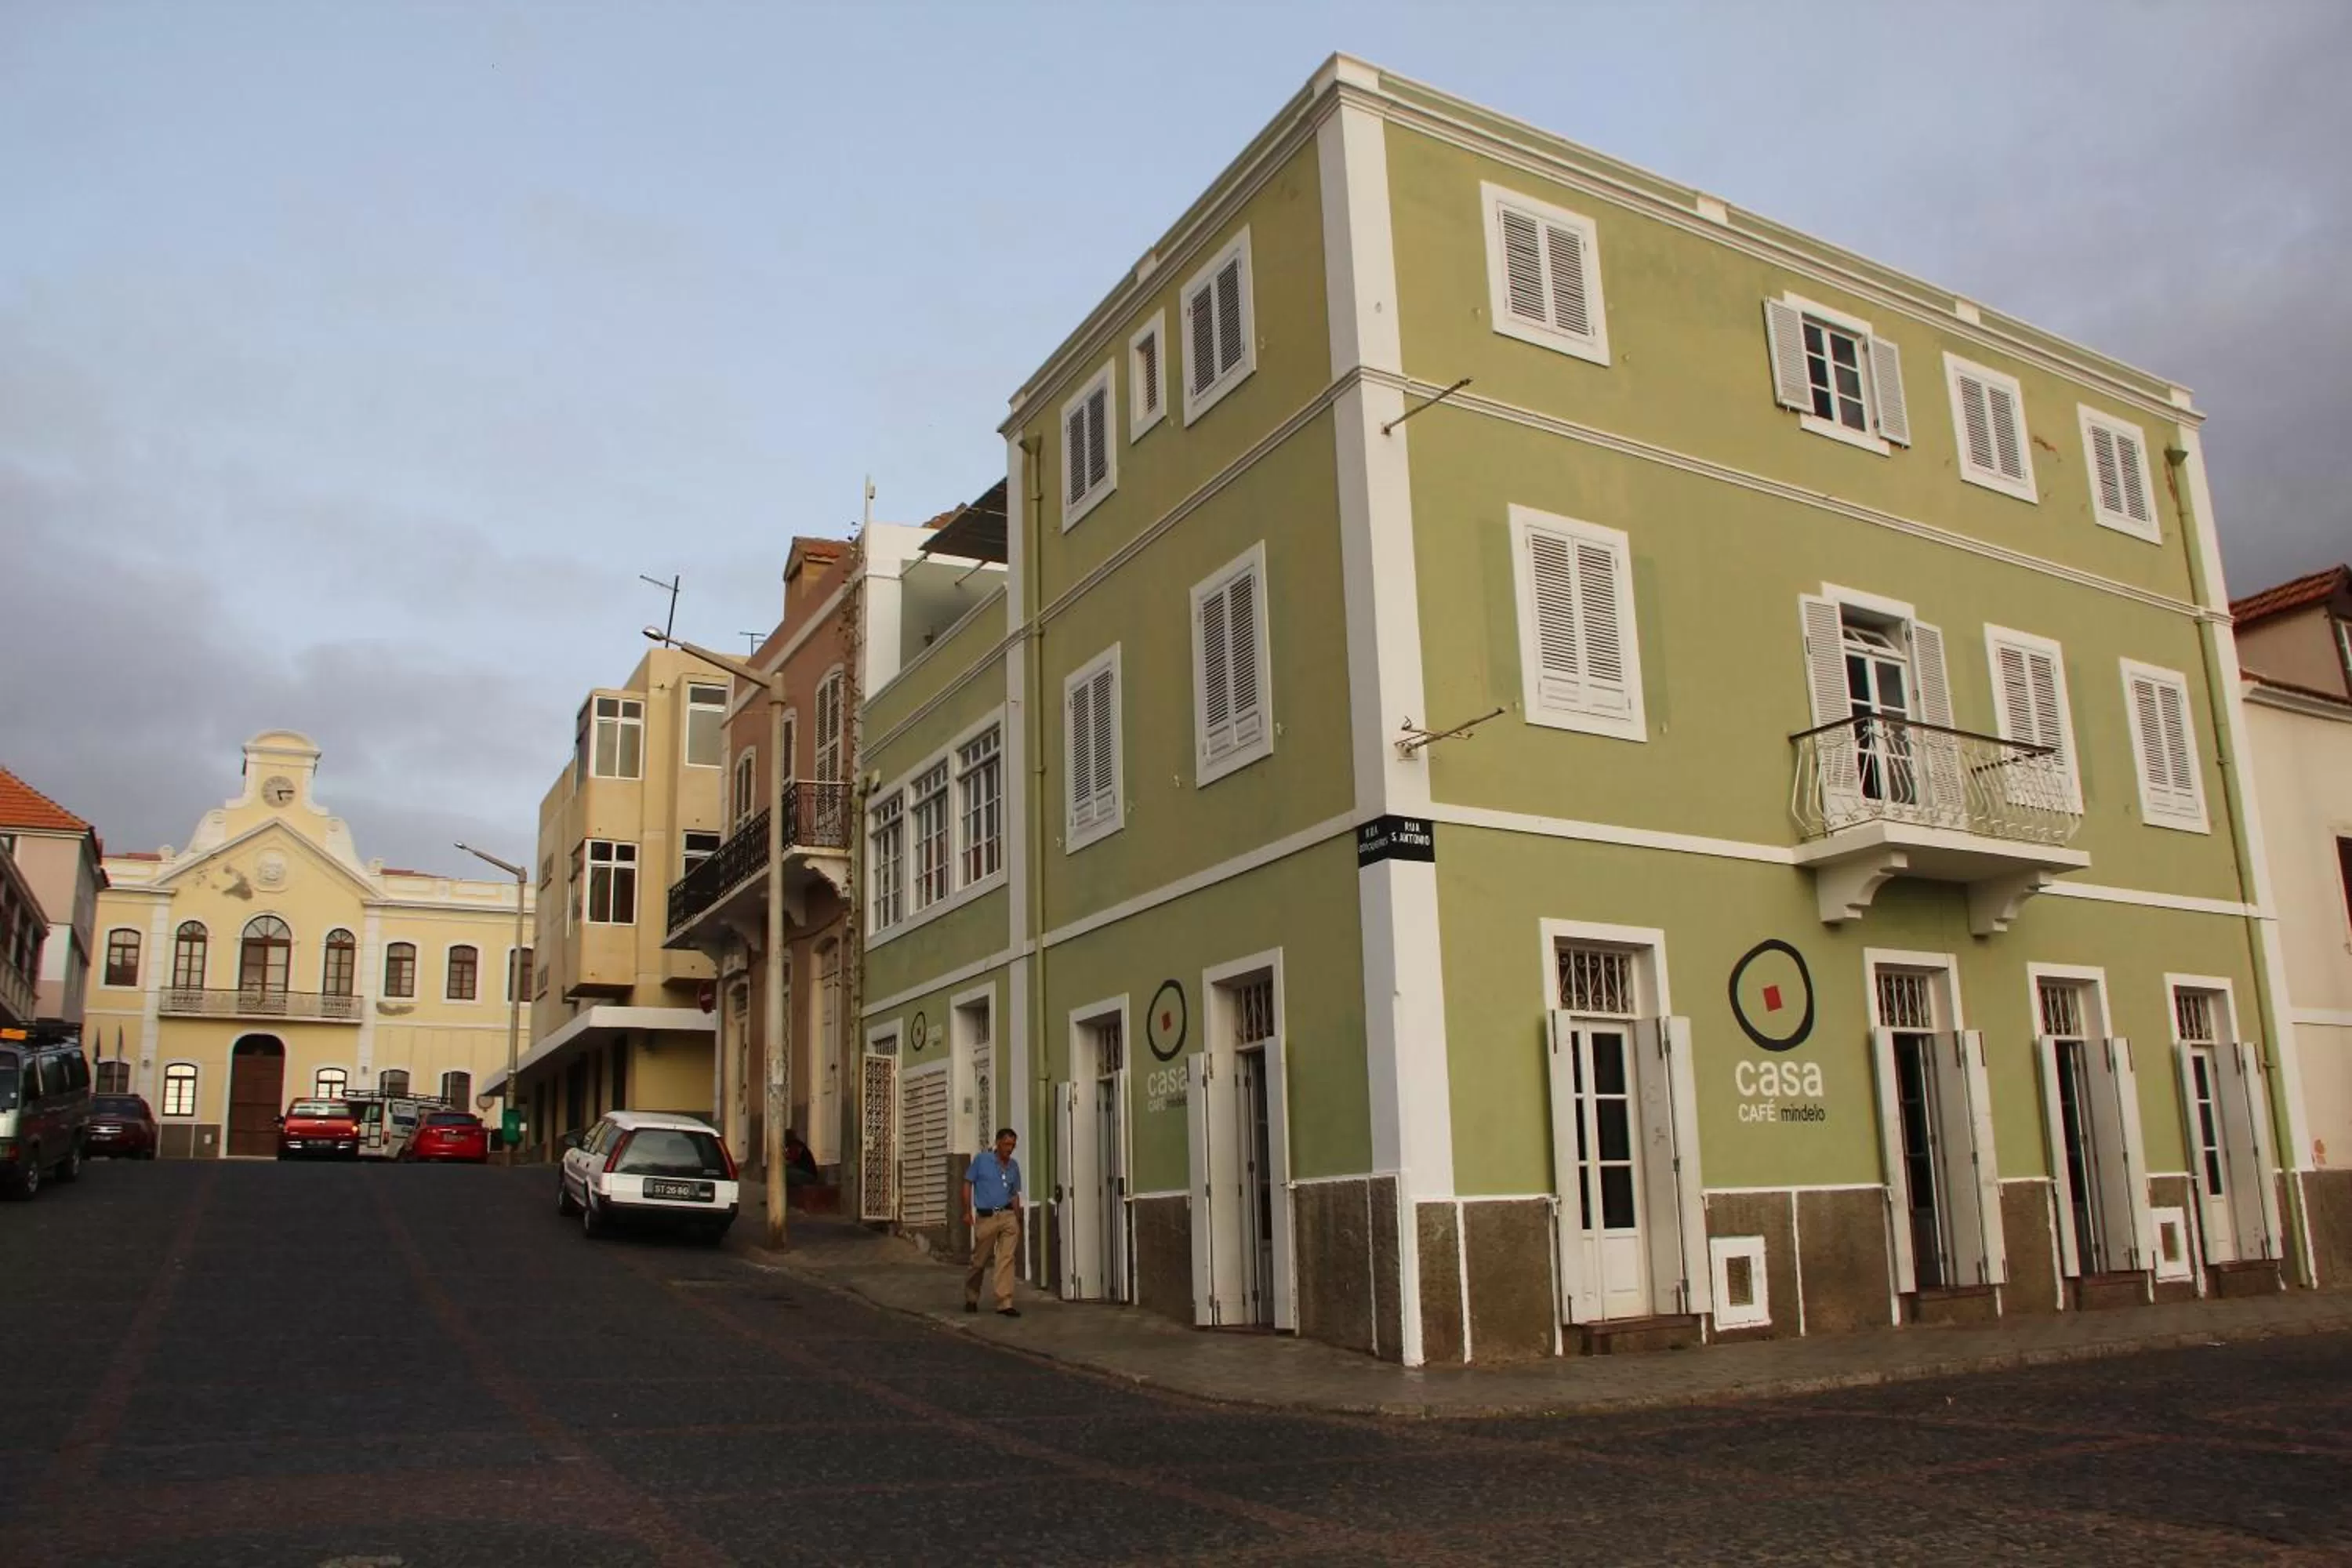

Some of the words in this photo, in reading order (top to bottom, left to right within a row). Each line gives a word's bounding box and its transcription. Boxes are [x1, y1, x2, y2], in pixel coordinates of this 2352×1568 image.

[1404, 821, 1420, 832] RUA
[1147, 1066, 1188, 1098] casa
[1735, 1060, 1824, 1097] casa
[1738, 1098, 1777, 1122] CAFÉ
[1780, 1103, 1826, 1122] mindelo
